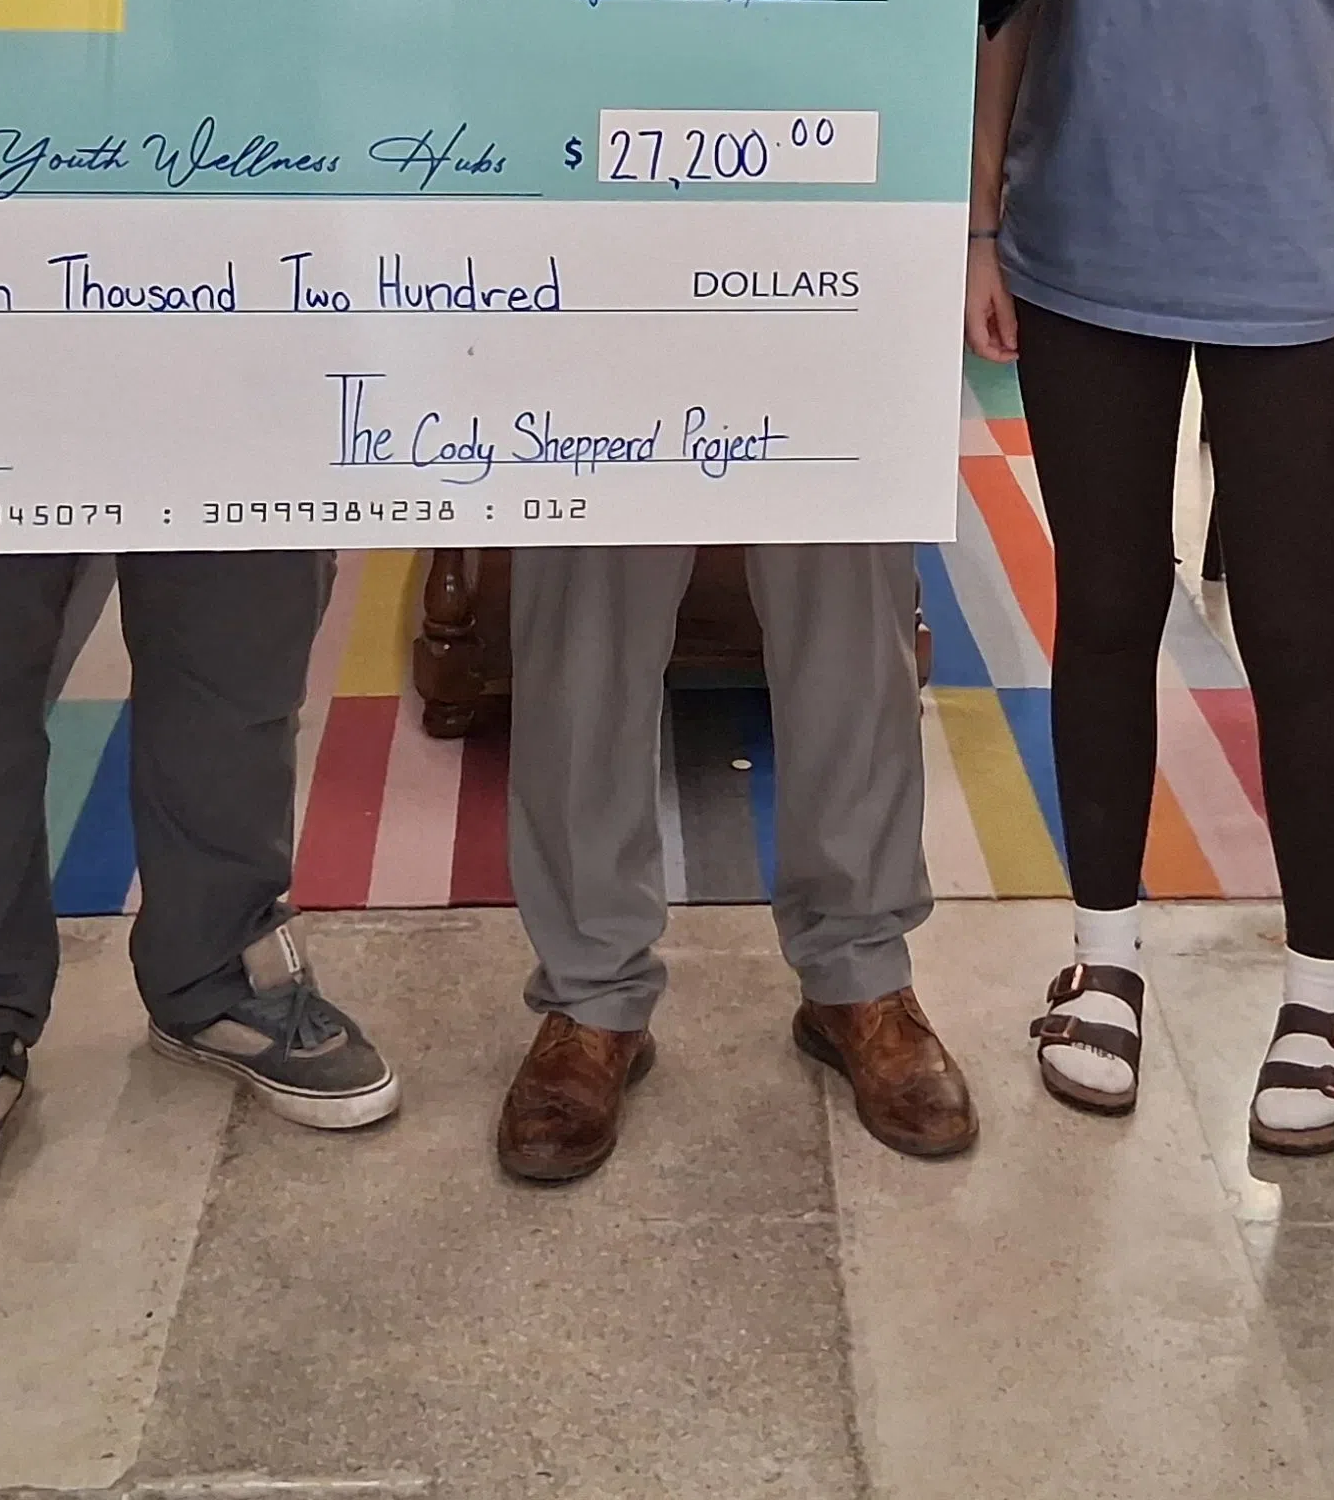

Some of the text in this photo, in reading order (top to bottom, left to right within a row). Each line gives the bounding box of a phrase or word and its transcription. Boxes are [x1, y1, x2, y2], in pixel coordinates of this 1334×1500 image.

[142, 115, 342, 189] Wellness
[369, 122, 508, 192] Hubs
[563, 135, 583, 170] $
[48, 252, 237, 313] Thousand
[280, 251, 351, 313] Two
[378, 253, 562, 312] Hundred
[692, 271, 860, 298] DOLLARS
[325, 373, 789, 485] The Cody Shepperd Project
[202, 501, 455, 524] 30999384238
[523, 499, 587, 520] 012
